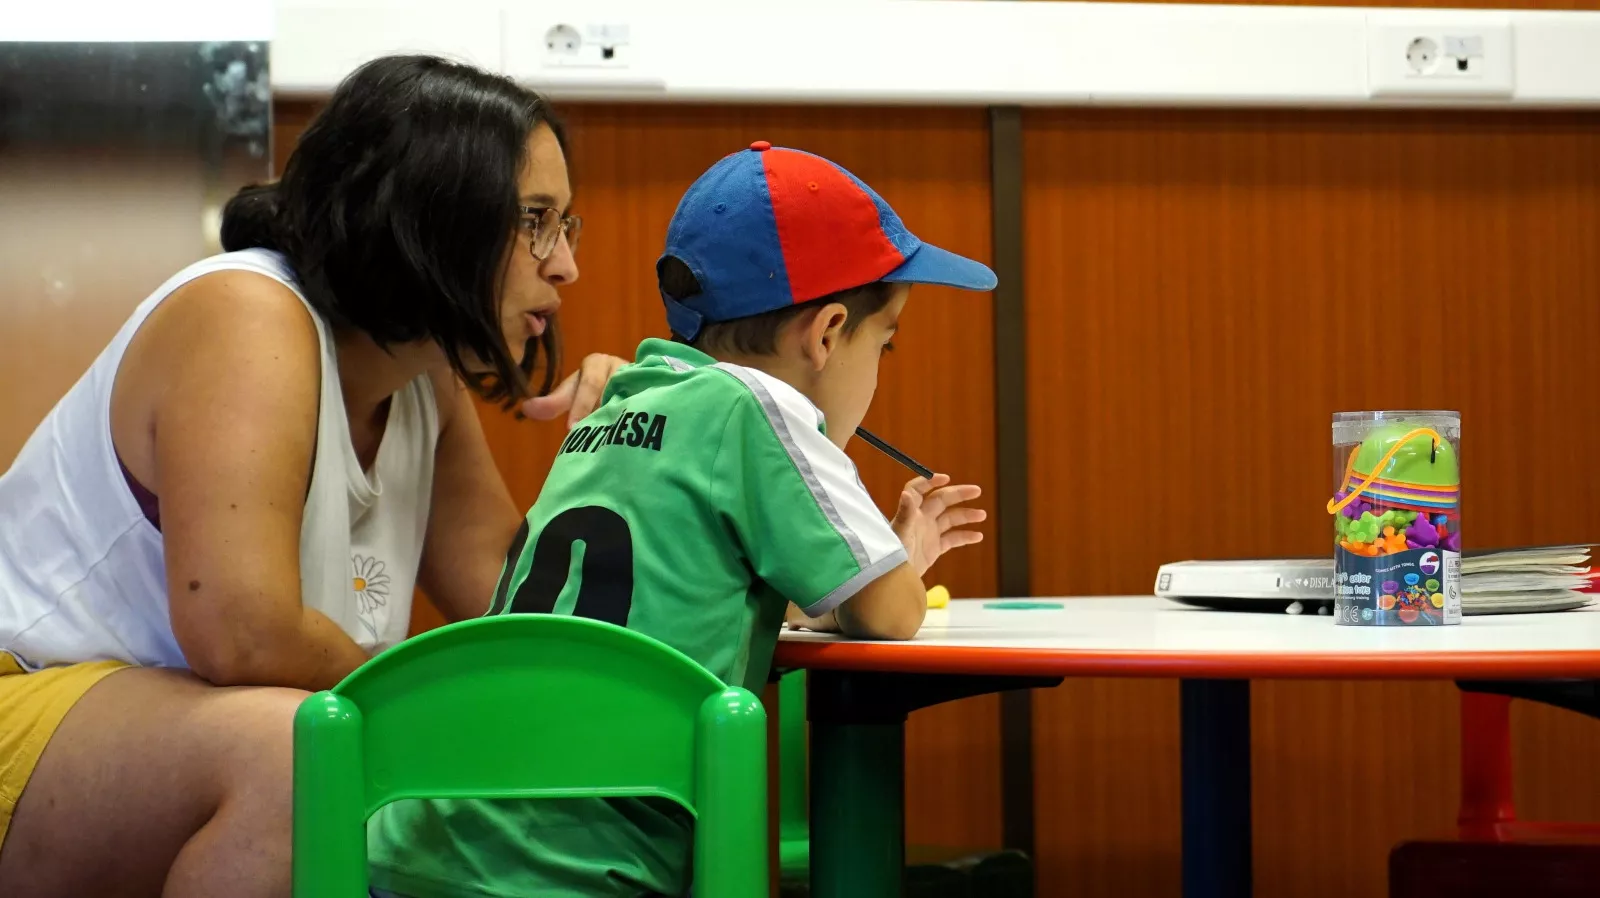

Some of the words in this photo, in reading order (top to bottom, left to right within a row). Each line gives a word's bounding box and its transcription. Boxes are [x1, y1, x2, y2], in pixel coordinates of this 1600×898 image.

[1309, 577, 1334, 588] DISPLA
[1349, 572, 1372, 584] color
[1354, 584, 1371, 595] toys
